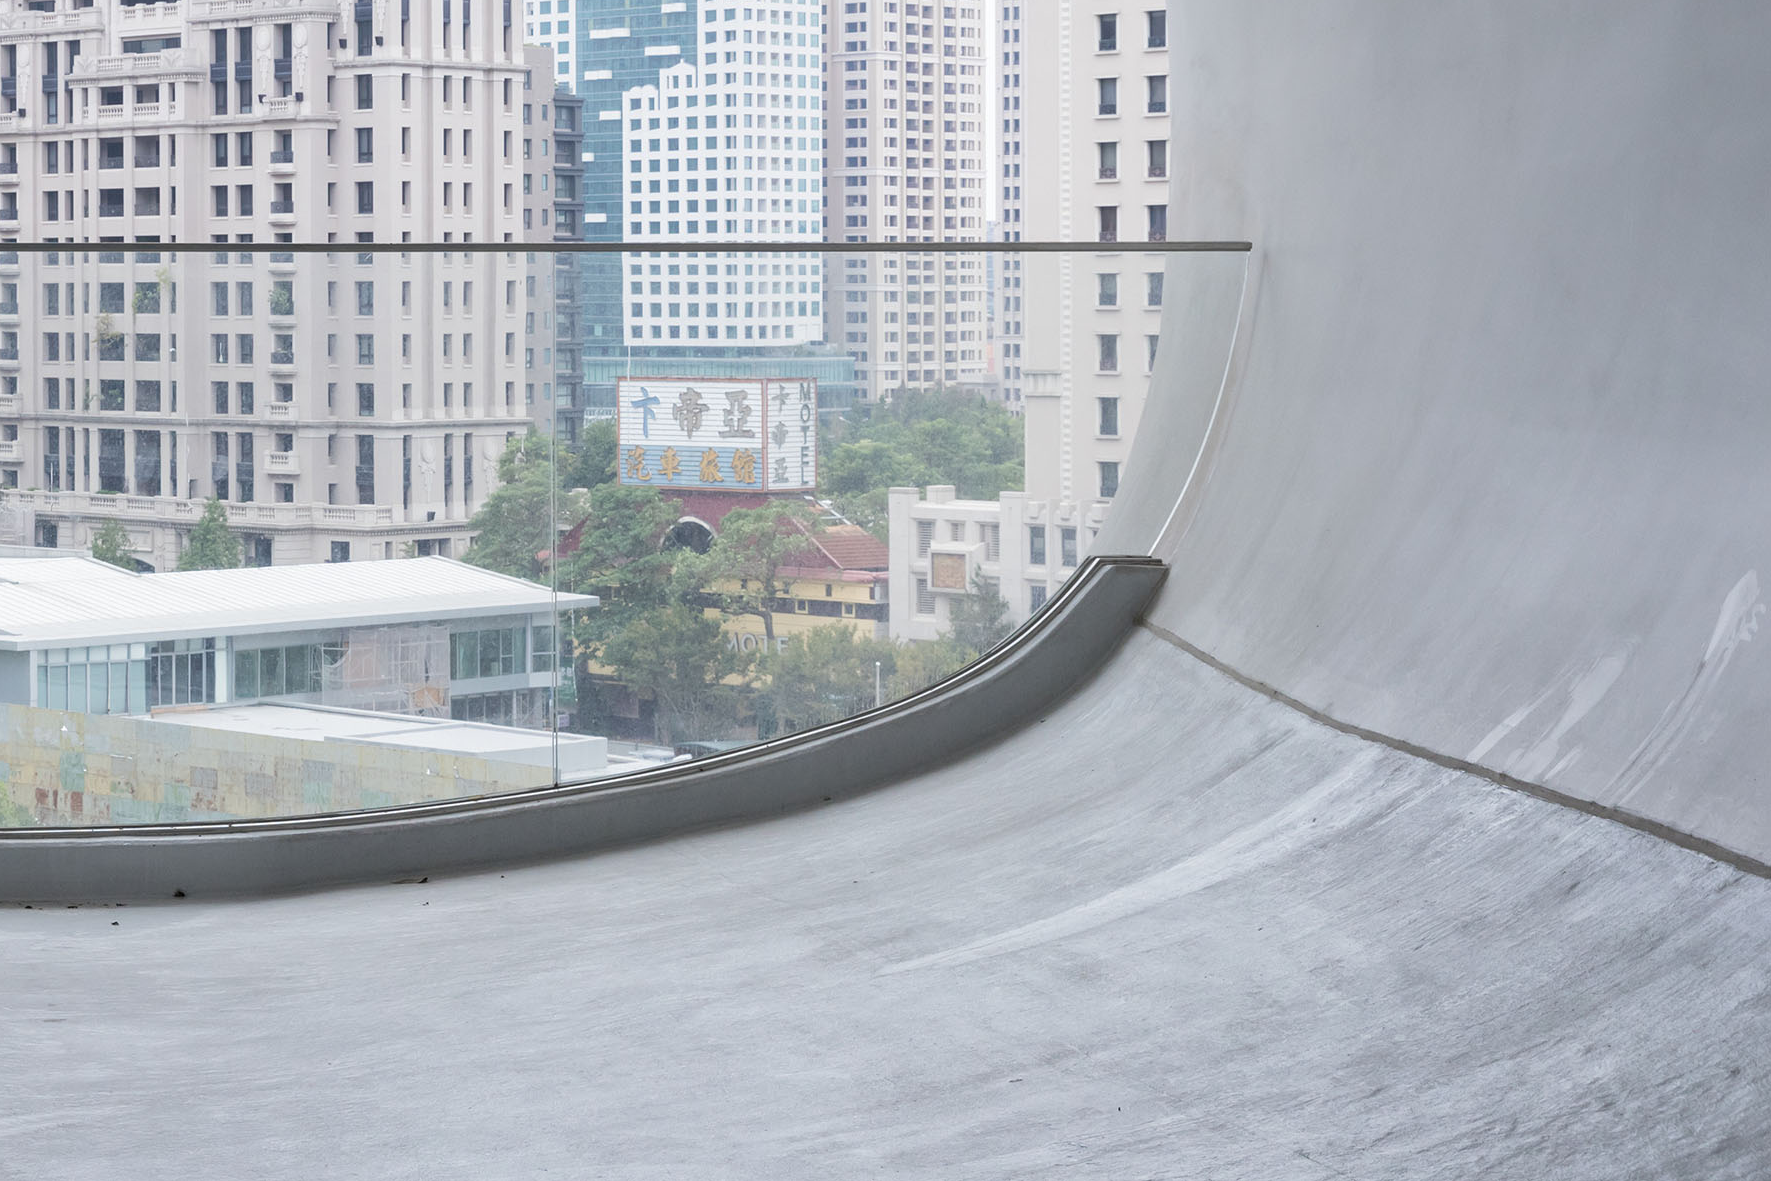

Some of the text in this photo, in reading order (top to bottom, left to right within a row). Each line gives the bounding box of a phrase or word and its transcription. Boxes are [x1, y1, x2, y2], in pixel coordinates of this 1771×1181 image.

[799, 380, 811, 485] MOTEL
[625, 444, 757, 485] 汽車旅館
[727, 632, 790, 656] MOTE
